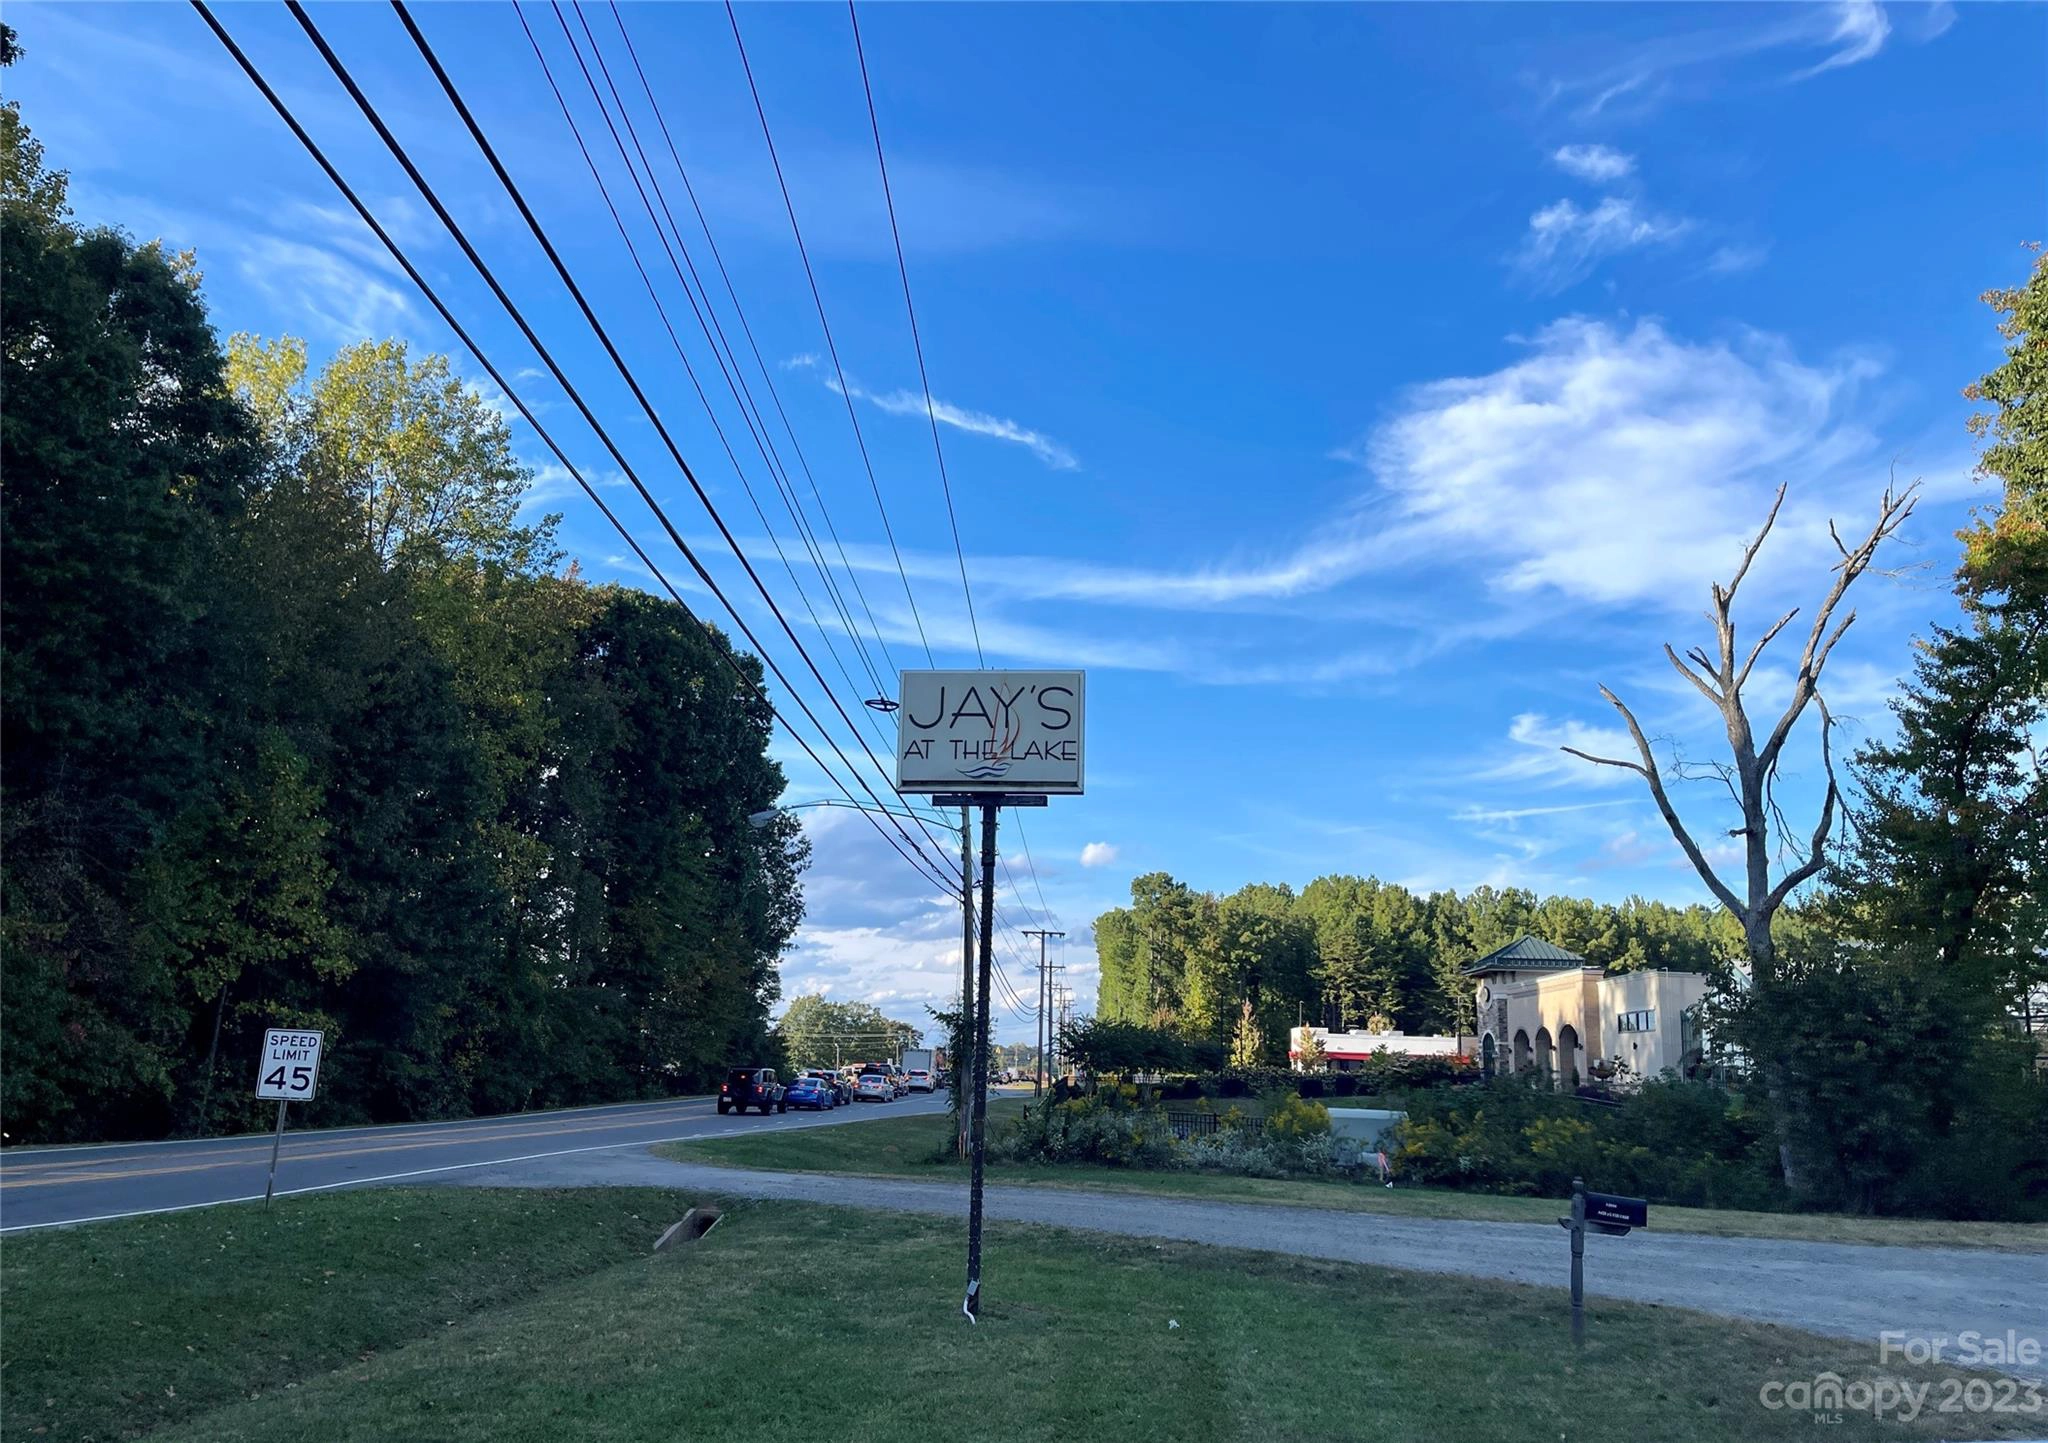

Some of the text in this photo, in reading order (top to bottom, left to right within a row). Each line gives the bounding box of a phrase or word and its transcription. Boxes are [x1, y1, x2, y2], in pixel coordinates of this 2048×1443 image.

[908, 685, 1074, 730] JAY'S
[903, 739, 1077, 761] AT THE LAKE
[270, 1034, 317, 1048] SPEED
[272, 1049, 310, 1061] LIMIT
[264, 1065, 312, 1092] 45
